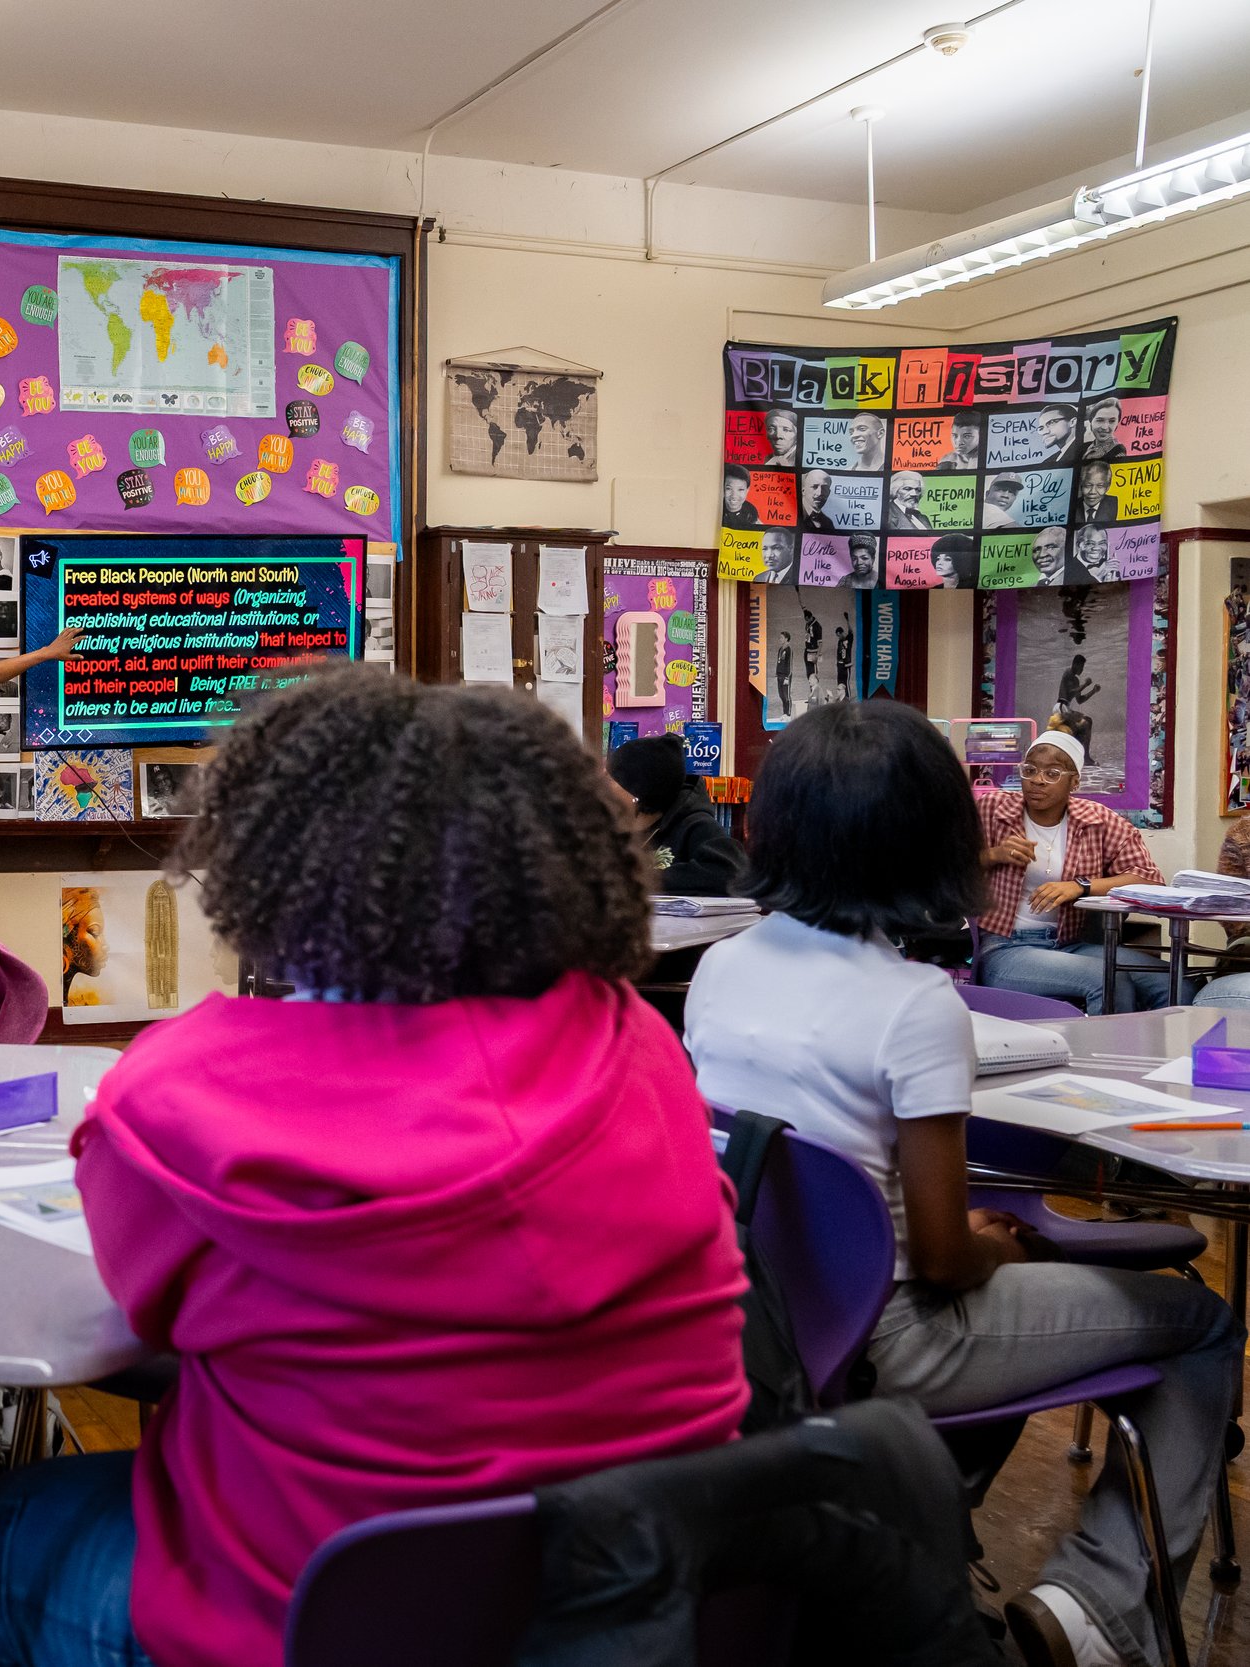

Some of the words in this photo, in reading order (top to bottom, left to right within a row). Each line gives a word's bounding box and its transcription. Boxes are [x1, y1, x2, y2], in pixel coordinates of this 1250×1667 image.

[27, 290, 42, 306] YOU
[25, 303, 53, 322] ENOUGH
[296, 322, 309, 337] BE
[290, 337, 313, 353] YOU
[740, 355, 890, 405] Black
[902, 341, 1161, 403] History
[29, 380, 44, 396] BE
[26, 398, 50, 412] YOU
[293, 405, 313, 418] STAY
[289, 418, 319, 427] POSITIVE
[726, 415, 764, 434] LEAD
[990, 418, 1037, 434] SPEAK
[1120, 411, 1166, 427] CHALLENGE
[823, 420, 849, 435] RUN
[897, 420, 945, 439] FIGHT
[1135, 426, 1154, 438] like
[208, 431, 222, 445] BE
[270, 435, 288, 454] YOU
[733, 434, 756, 448] like
[817, 438, 843, 453] like
[1003, 435, 1030, 447] like
[1131, 439, 1163, 452] Rosa
[207, 439, 235, 459] HAPPY
[725, 447, 763, 463] Harriet
[911, 446, 932, 458] like
[805, 451, 848, 467] Jesse
[893, 456, 939, 469] Muhammad
[987, 451, 1043, 466] Malcolm
[124, 473, 145, 489] STAY
[1024, 473, 1067, 504] Play
[122, 485, 152, 498] POSITIVE
[834, 485, 879, 497] EDUCATE
[927, 487, 975, 502] REFORM
[1132, 488, 1152, 499] like
[767, 497, 784, 507] like
[848, 501, 865, 510] like
[939, 501, 958, 512] like
[1022, 500, 1049, 513] like
[1124, 502, 1160, 517] Nelson
[767, 508, 792, 521] Mae
[835, 512, 876, 526] W.E.B.
[930, 515, 974, 529] Frederick
[1023, 513, 1066, 526] Jackie
[723, 532, 759, 550] Dream
[1114, 529, 1158, 550] Inspire
[802, 540, 838, 557] Write
[887, 549, 931, 562] PROTEST
[982, 543, 1032, 559] INVENT
[734, 552, 751, 563] like
[814, 558, 832, 570] like
[1129, 552, 1149, 563] like
[636, 565, 657, 576] DREAM
[656, 566, 667, 576] BIG
[717, 560, 755, 577] Martin
[902, 562, 921, 574] like
[996, 562, 1016, 573] like
[1121, 564, 1154, 578] Louis
[64, 568, 97, 584] Free
[100, 568, 136, 584] Black
[138, 567, 185, 586] People
[187, 566, 228, 585] (North
[230, 567, 256, 583] and
[258, 566, 300, 584] South)
[803, 570, 831, 586] Maya
[894, 573, 927, 588] Angela
[981, 574, 1024, 588] George
[64, 591, 120, 607] created
[122, 590, 177, 610] systems
[179, 589, 194, 606] of
[196, 591, 230, 608] ways
[233, 588, 307, 608] (Organizing,
[65, 612, 147, 632] establishing
[149, 611, 227, 628] educational
[228, 610, 300, 627] institutions,
[303, 612, 320, 625] or
[877, 602, 894, 642] WORK
[72, 634, 120, 654] uilding
[122, 634, 182, 653] religious
[183, 631, 259, 649] institutions)
[260, 632, 285, 647] that
[287, 631, 332, 649] helped
[334, 631, 347, 646] to
[64, 657, 122, 676] support,
[124, 656, 149, 673] aid,
[151, 655, 177, 671] and
[180, 654, 214, 673] uplift
[216, 654, 249, 670] their
[875, 644, 893, 680] HARD
[64, 679, 91, 695] and
[93, 678, 127, 694] their
[129, 676, 179, 696] people!
[190, 676, 227, 695] Being
[228, 675, 260, 691] FREE
[65, 702, 111, 717] others
[113, 700, 128, 715] to
[130, 700, 148, 715] be
[150, 699, 178, 714] and
[178, 698, 202, 713] live
[686, 741, 720, 761] 1619
[693, 760, 713, 768] Project
